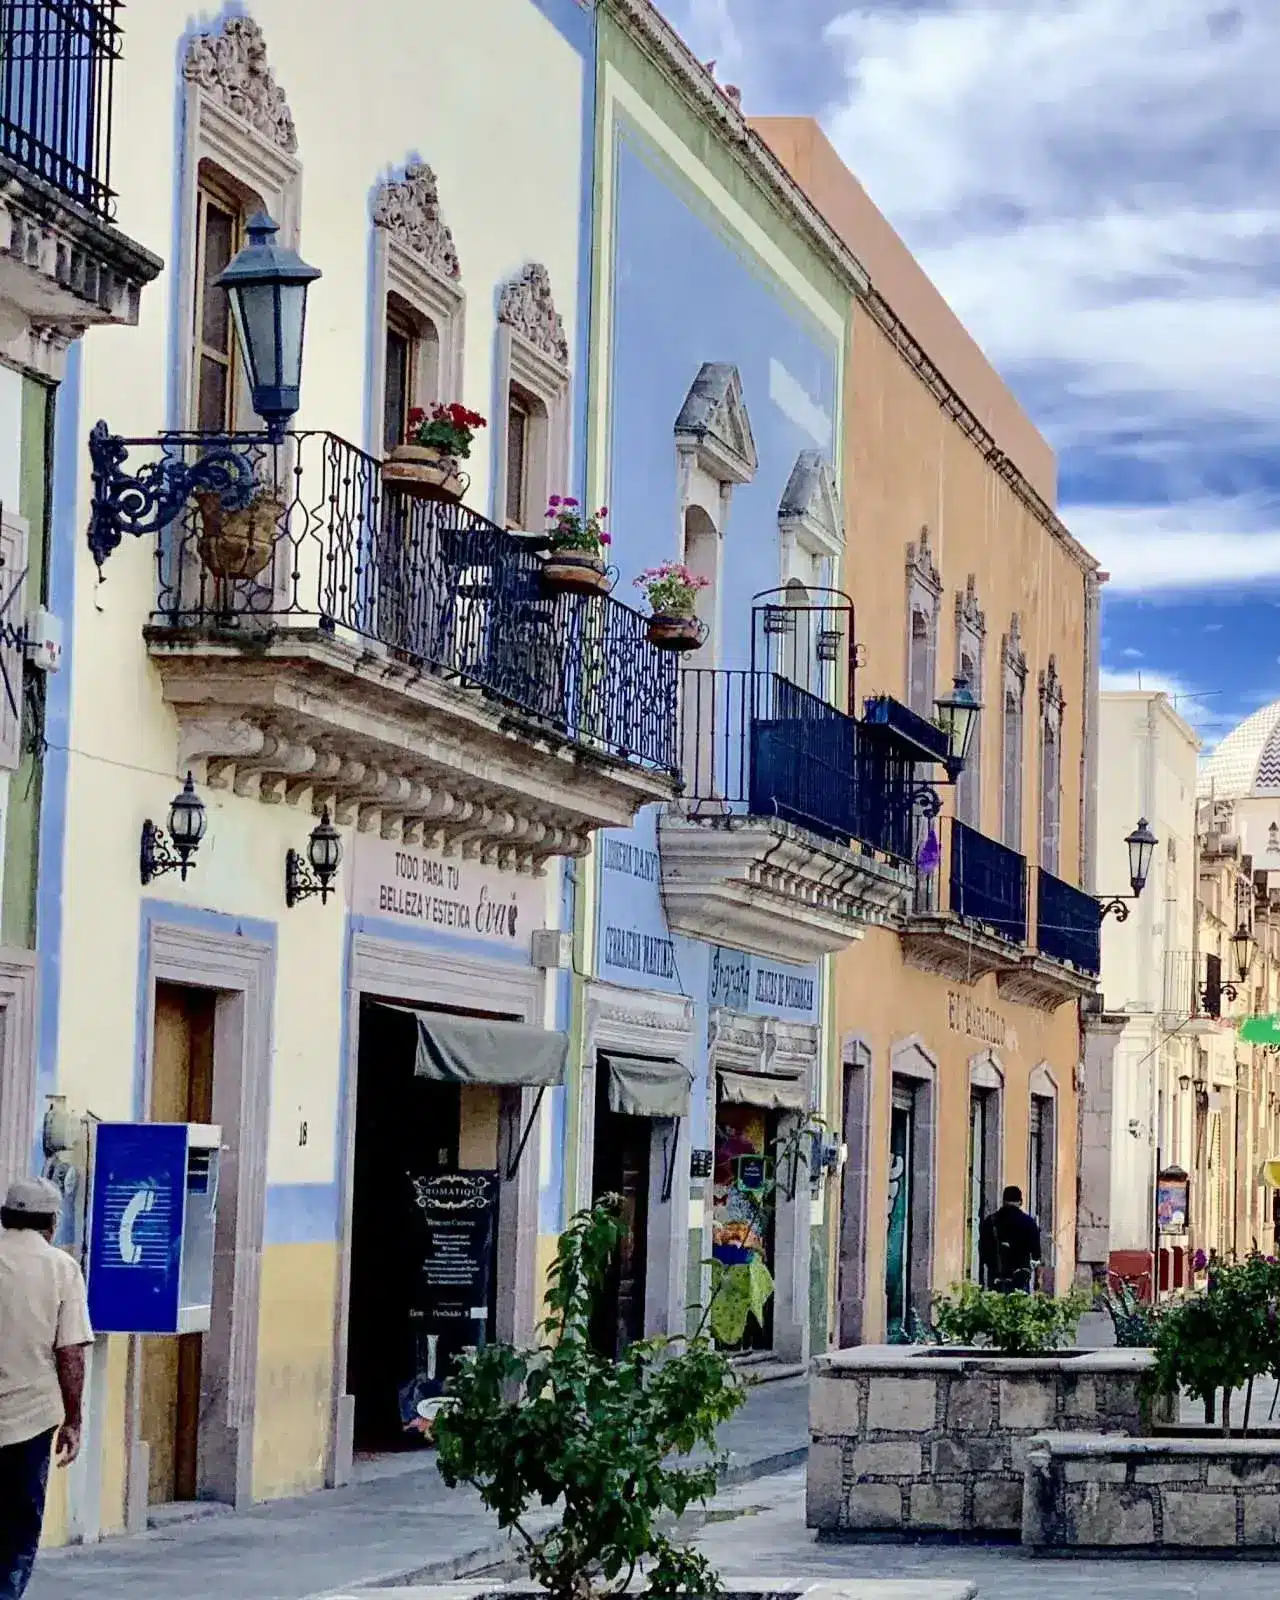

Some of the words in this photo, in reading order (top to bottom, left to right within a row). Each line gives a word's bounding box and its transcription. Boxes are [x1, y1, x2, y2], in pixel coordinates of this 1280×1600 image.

[396, 851, 418, 881] TODO
[422, 858, 443, 888] PARA
[447, 866, 459, 891] TU
[379, 884, 423, 918] BELLEZA
[424, 895, 430, 920] Y
[433, 898, 470, 929] ESTETICA
